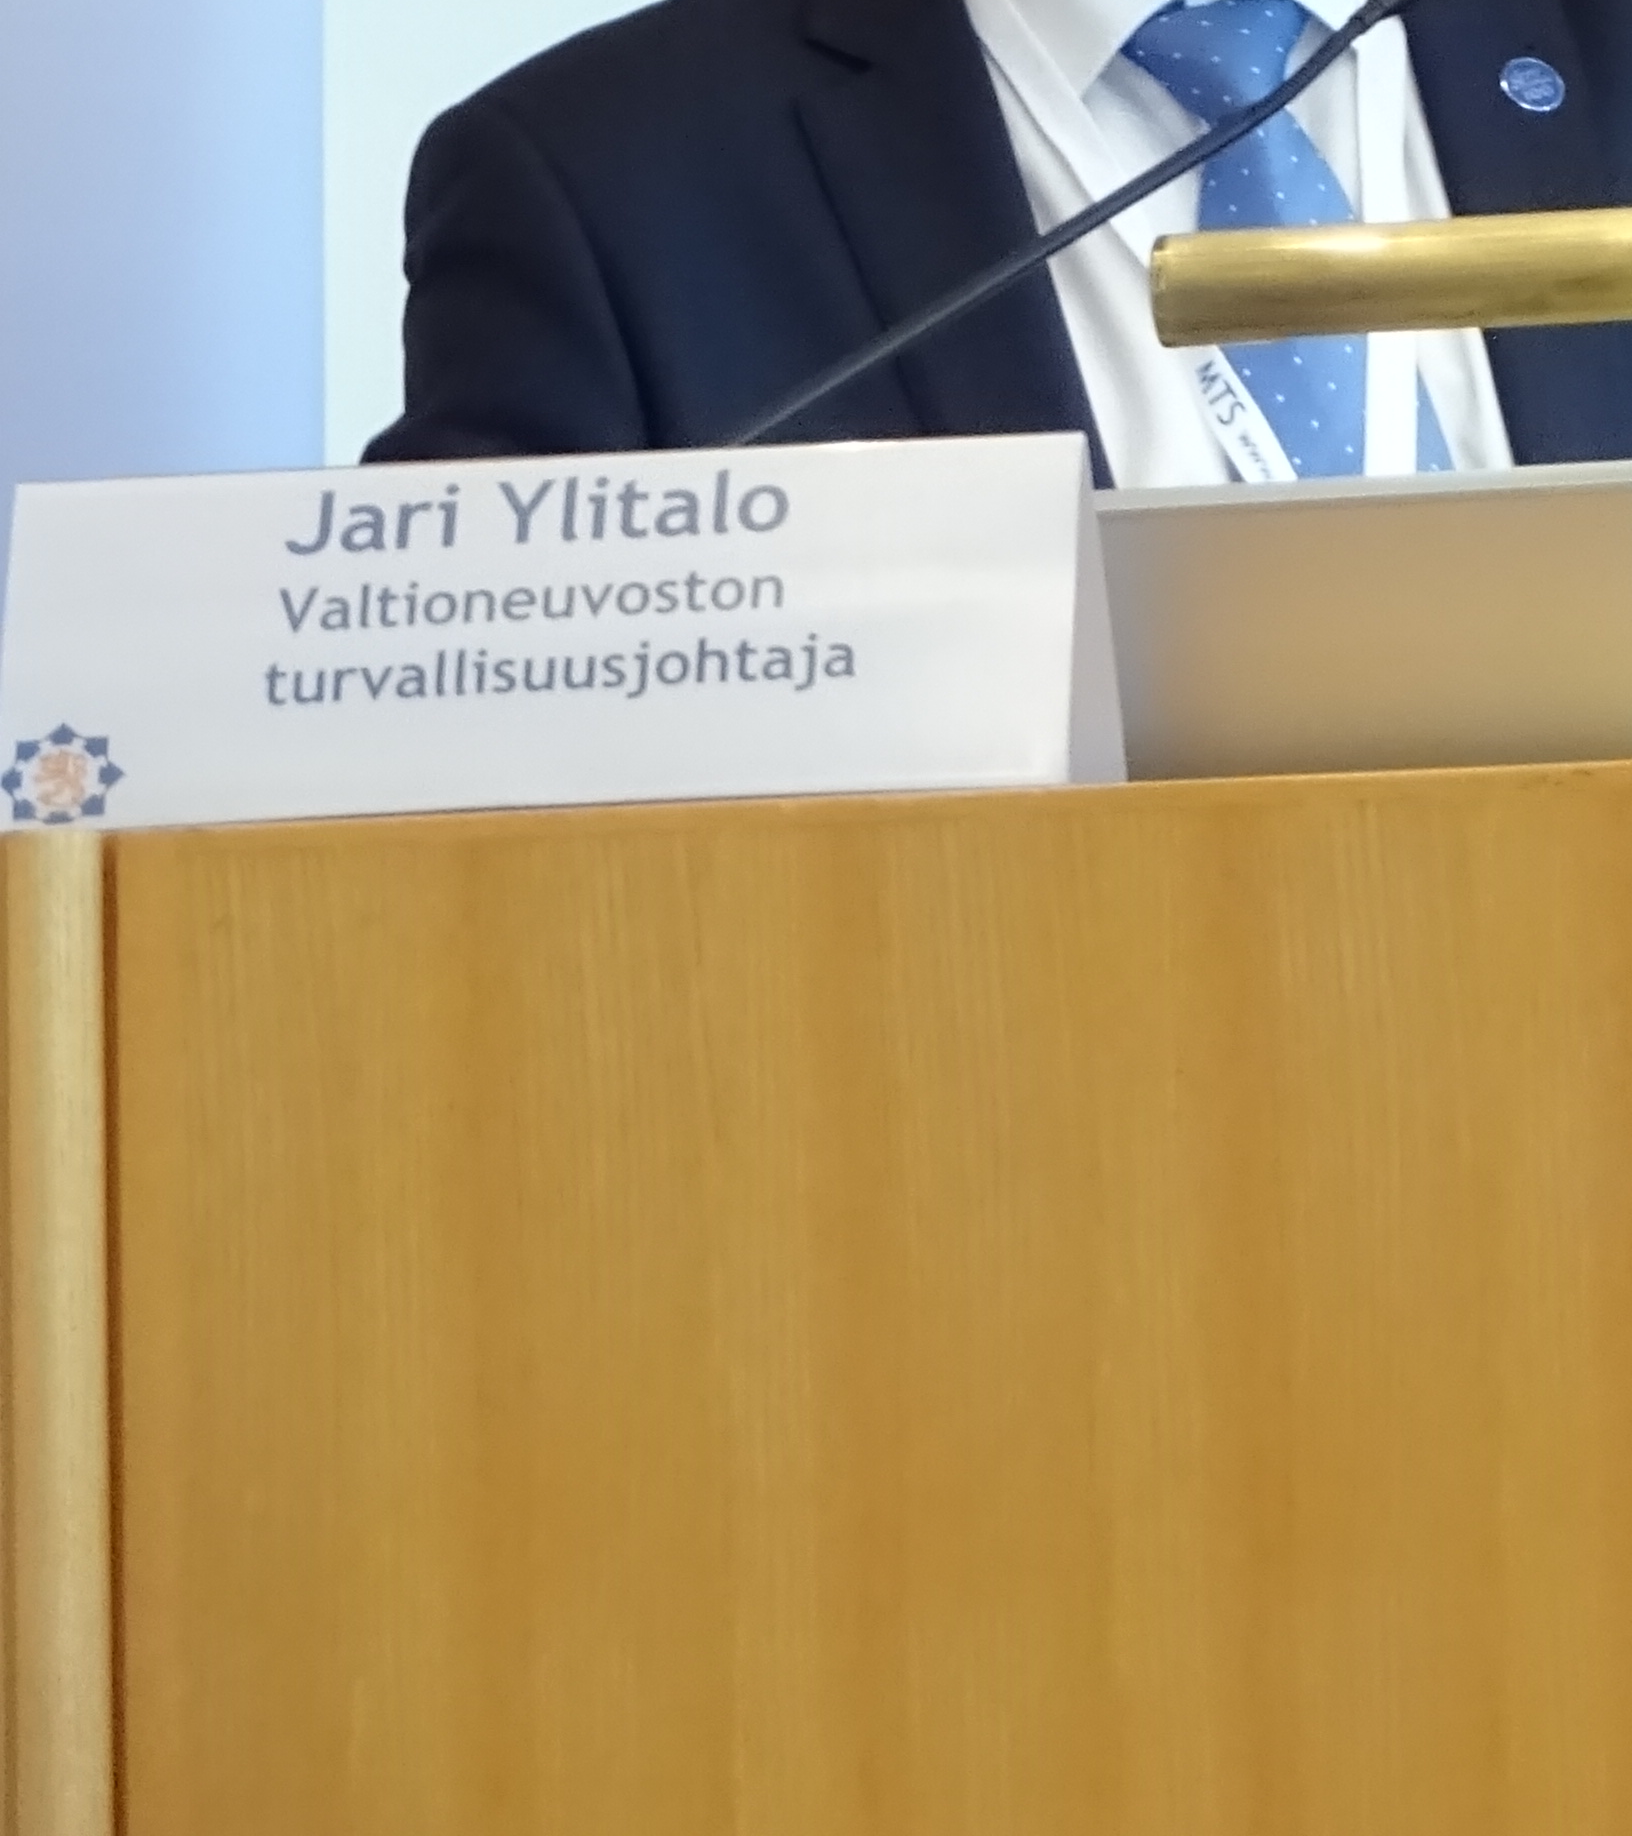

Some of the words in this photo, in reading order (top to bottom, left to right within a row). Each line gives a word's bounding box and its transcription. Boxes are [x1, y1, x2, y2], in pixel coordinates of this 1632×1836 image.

[1196, 360, 1246, 425] MTS
[284, 482, 461, 557] Jari
[497, 468, 791, 546] Ylitalo
[279, 570, 785, 635] Valtioneuvoston
[263, 634, 857, 707] turvallisuusjohtaja
